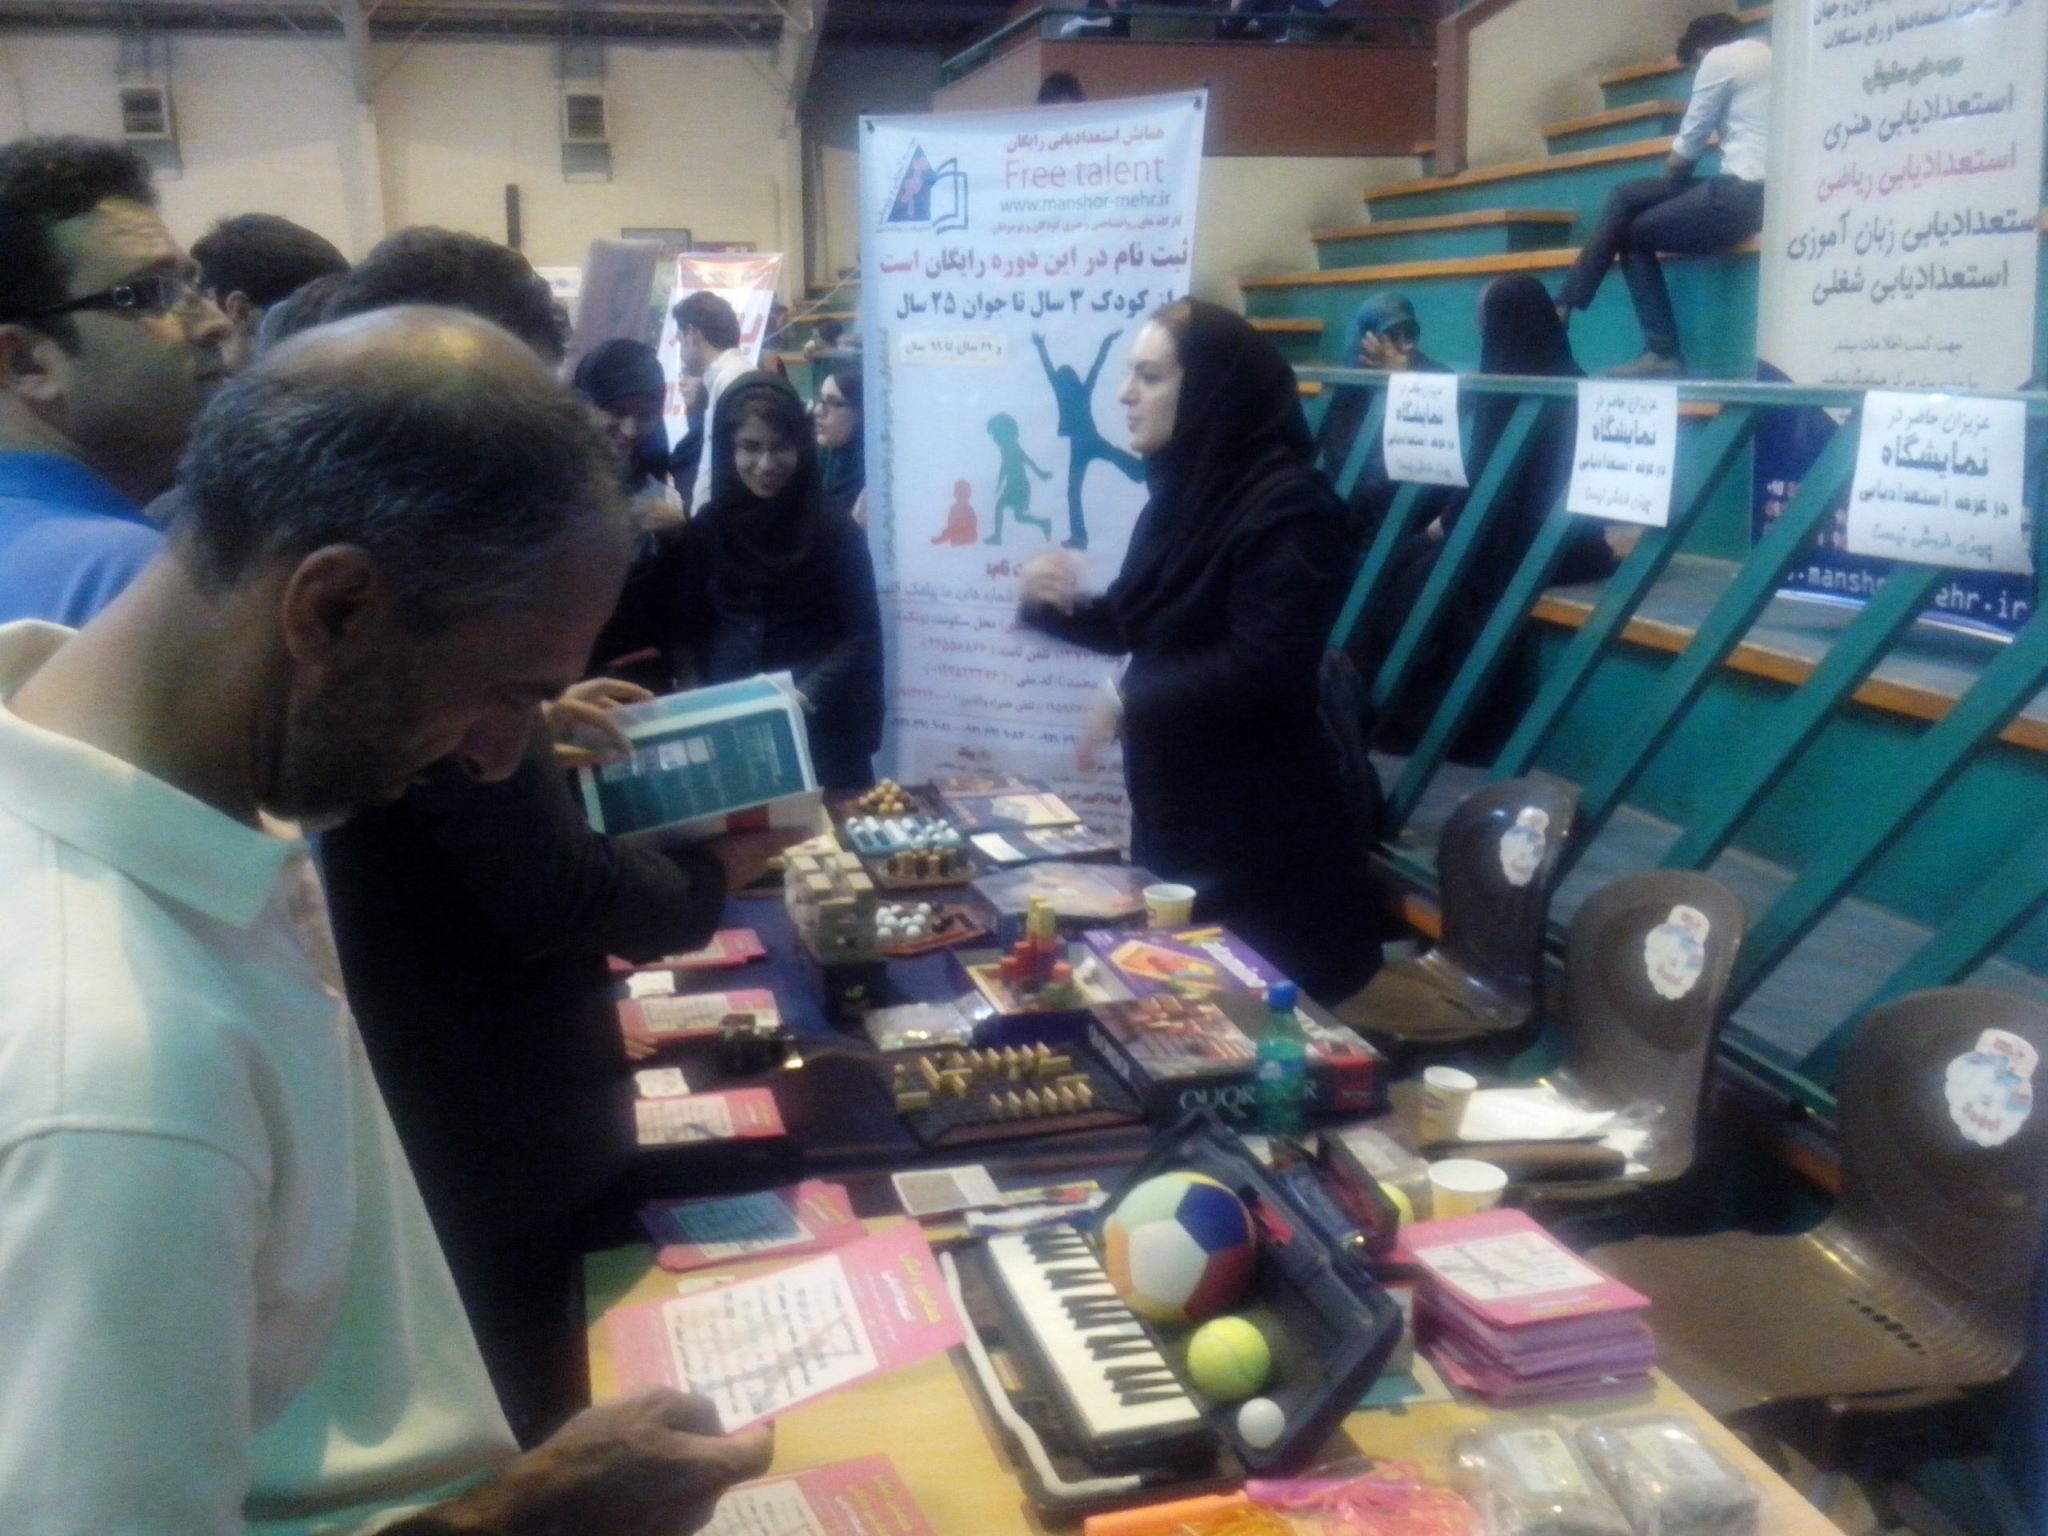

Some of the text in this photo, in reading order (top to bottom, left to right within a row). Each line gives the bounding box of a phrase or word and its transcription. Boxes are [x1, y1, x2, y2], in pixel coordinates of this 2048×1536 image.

[1823, 83, 2015, 150] استعدادیابی هنری
[1007, 133, 1045, 153] رایگان
[1048, 127, 1119, 151] استعدادیابی
[1005, 152, 1165, 188] Free talent
[1817, 141, 2018, 202] استعدادیابی ریاضی
[1000, 189, 1171, 213] www.manshor-mehr.ir
[1786, 207, 2038, 261] ستعدادیابی زبان آموزی
[879, 237, 1188, 279] ثبت نام در این دوره رایگان است
[1811, 259, 2009, 306] استعدادیابی شغلی
[896, 290, 928, 320] سال
[931, 289, 957, 315] ۲۵
[962, 292, 1007, 320] جوان
[1012, 291, 1026, 312] تا
[1030, 290, 1065, 319] سال
[1070, 287, 1084, 313] ۳
[1091, 288, 1149, 318] کودک
[1592, 415, 1656, 449] نمایشگاه
[1881, 431, 1989, 479] نمایشگاه
[1993, 500, 2010, 519] در
